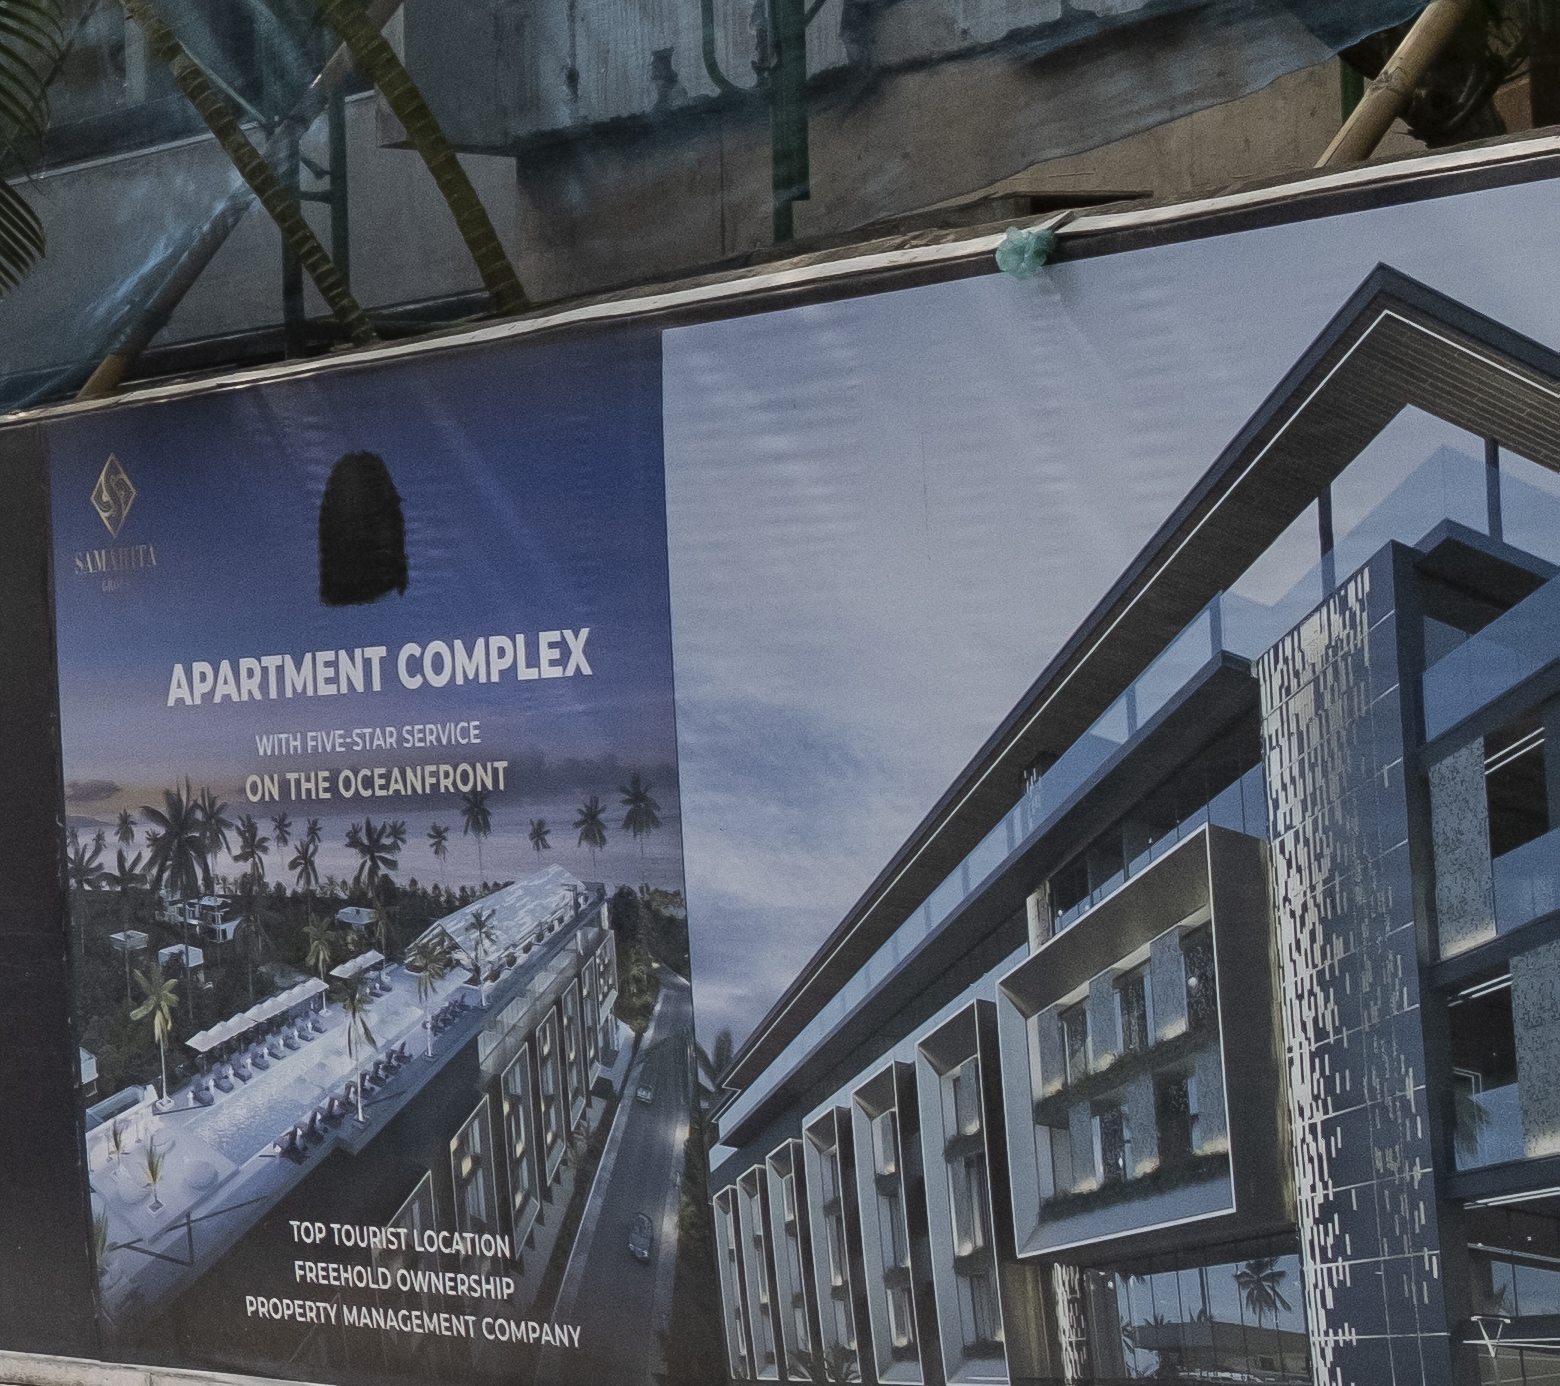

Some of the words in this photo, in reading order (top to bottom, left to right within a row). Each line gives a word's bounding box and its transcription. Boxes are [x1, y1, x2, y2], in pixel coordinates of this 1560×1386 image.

[167, 646, 387, 707] APARTMENT
[397, 627, 593, 691] COMPLEX
[255, 731, 302, 757] WITH
[306, 726, 398, 753] FIVE-STAR
[402, 720, 482, 749] SERVICE
[245, 772, 280, 803] ON
[284, 769, 332, 801] THE
[338, 761, 508, 798] OCEANFRONT
[289, 1221, 326, 1244] TOP
[330, 1223, 407, 1251] TOURIST
[413, 1229, 511, 1259] LOCATION
[294, 1260, 391, 1290] FREEHOLD
[396, 1269, 515, 1301] OWNERSHIP
[245, 1295, 337, 1325] PROPERTY
[343, 1304, 476, 1338] MANAGEMENT
[482, 1317, 581, 1349] COMPANY
